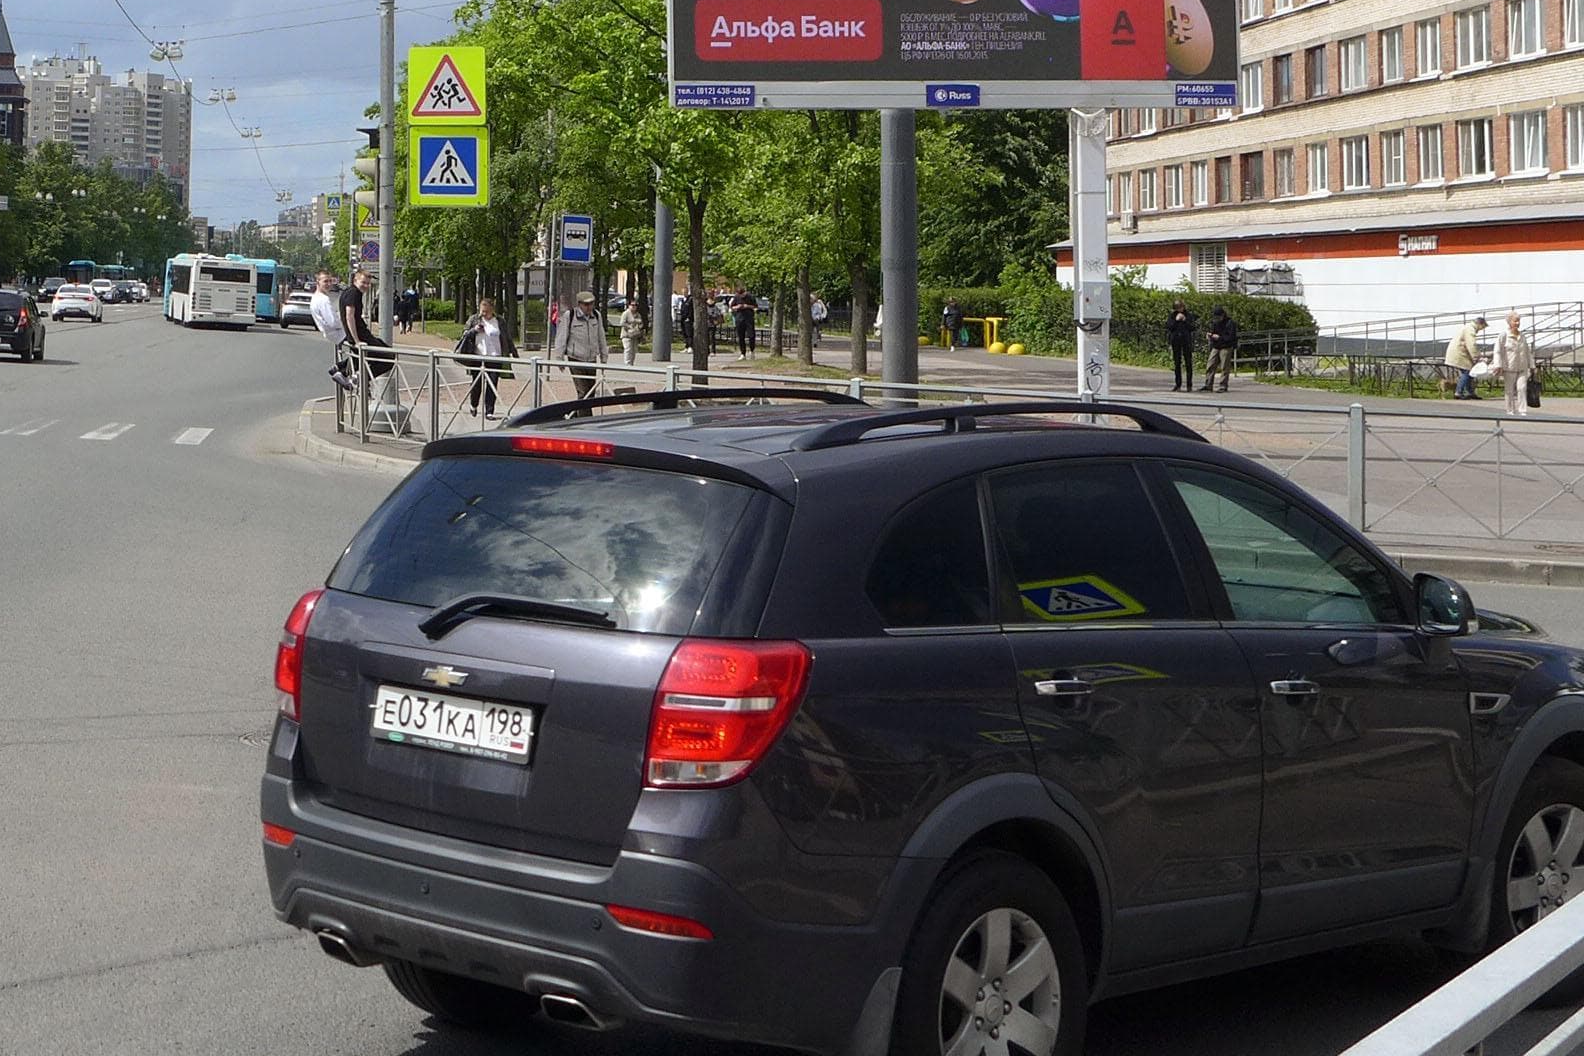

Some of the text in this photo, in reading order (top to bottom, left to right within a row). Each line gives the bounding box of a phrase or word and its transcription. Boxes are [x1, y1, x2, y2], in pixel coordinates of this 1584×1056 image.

[711, 15, 866, 45] Альфа Банк
[901, 42, 912, 51] АО
[949, 91, 972, 100] Russ
[486, 707, 522, 736] 198
[490, 734, 509, 745] RUS
